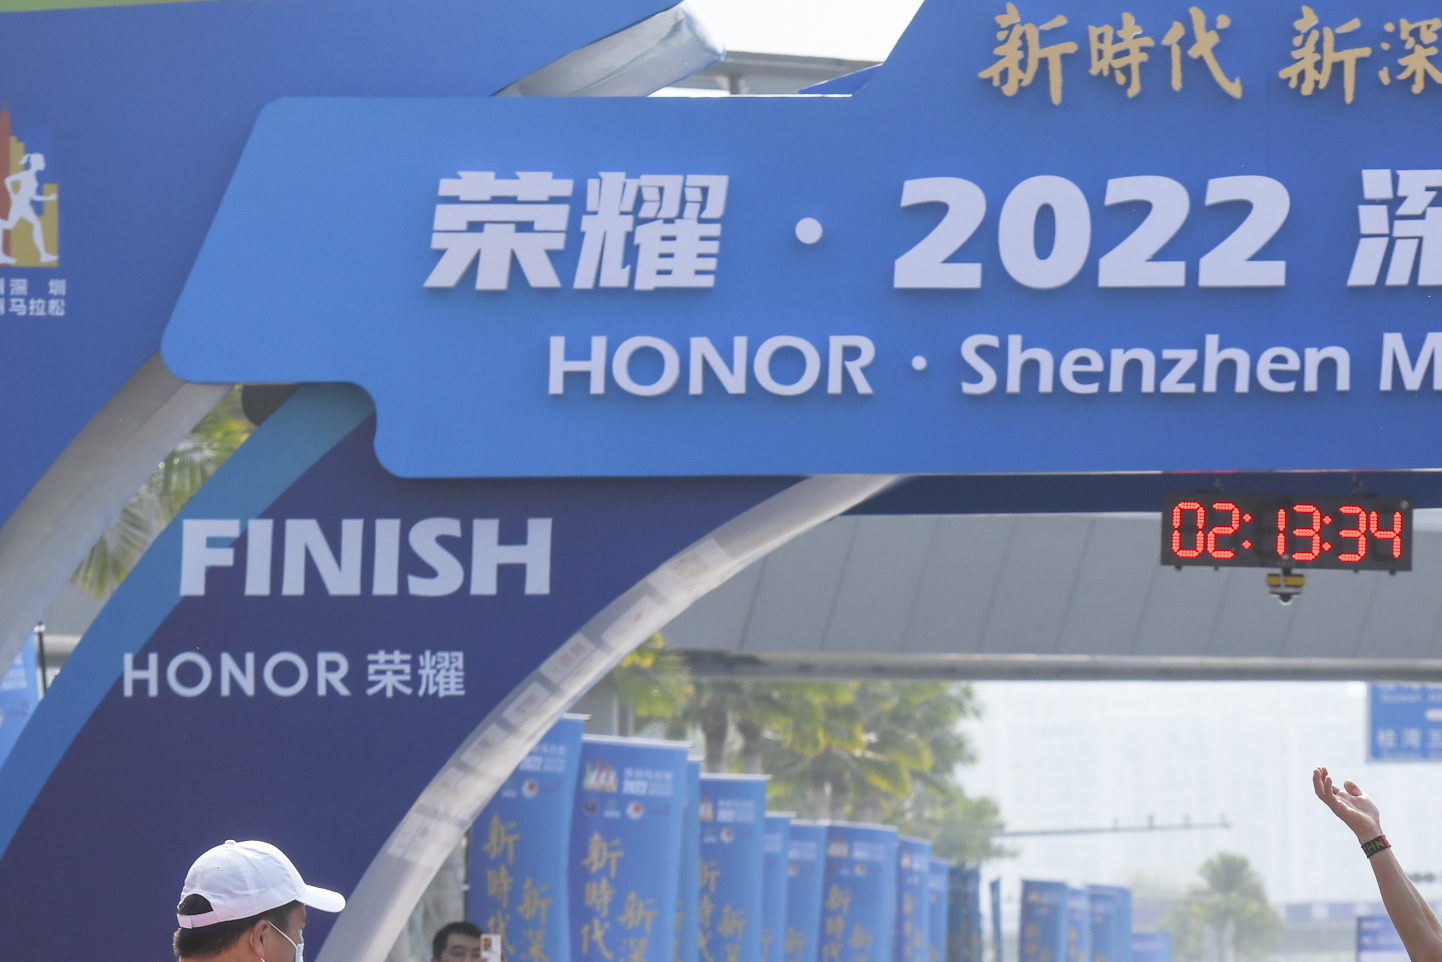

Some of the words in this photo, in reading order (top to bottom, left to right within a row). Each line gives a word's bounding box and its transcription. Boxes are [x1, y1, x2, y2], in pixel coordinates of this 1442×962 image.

[978, 7, 1242, 105] 新時代
[423, 171, 729, 291] 荣耀
[893, 175, 1291, 290] 2022
[0, 297, 66, 316] 马拉松
[548, 335, 876, 397] HONOR
[960, 334, 1351, 395] Shenzhen
[179, 517, 553, 597] FINISH
[1172, 501, 1403, 563] 02:13:34
[123, 651, 351, 698] HONOR
[366, 649, 466, 698] 荣耀
